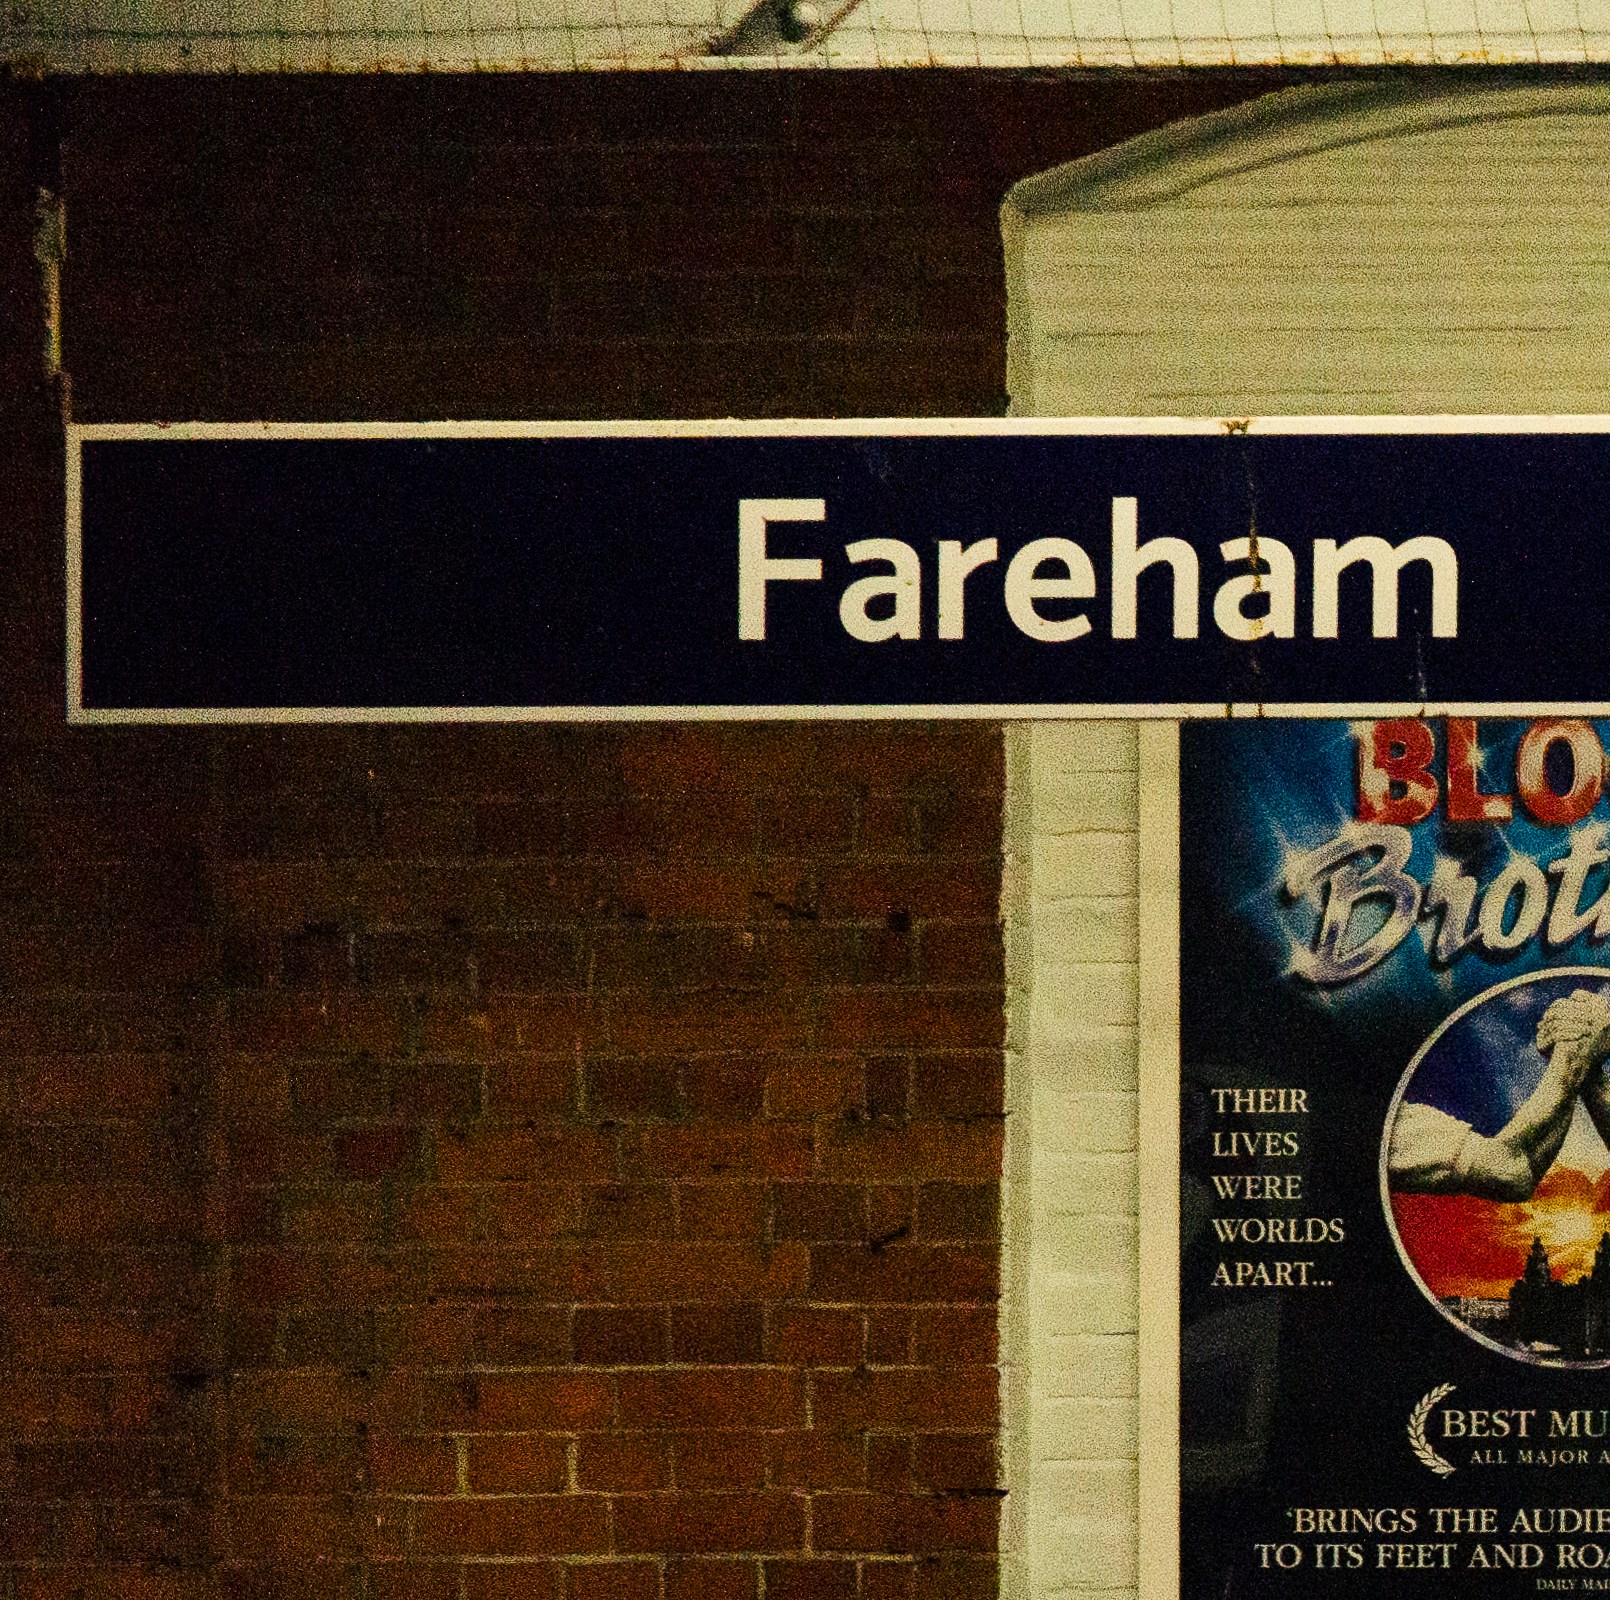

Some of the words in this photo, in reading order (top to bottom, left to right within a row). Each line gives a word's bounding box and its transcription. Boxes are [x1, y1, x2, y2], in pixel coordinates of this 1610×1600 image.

[739, 497, 1458, 642] Fareham
[1212, 1089, 1308, 1113] THEIR
[1214, 1132, 1299, 1156] LIVES
[1212, 1175, 1301, 1199] WERE
[1212, 1218, 1344, 1242] WORLDS
[1212, 1262, 1332, 1286] APART...
[1444, 1410, 1536, 1437] BEST
[1471, 1450, 1506, 1463] ALL
[1519, 1450, 1588, 1467] MAJOR
[1430, 1508, 1497, 1532] THE
[1255, 1544, 1302, 1568] TO
[1316, 1544, 1363, 1568] ITS
[1377, 1544, 1457, 1568] FEET
[1469, 1544, 1544, 1568] AND
[1536, 1578, 1574, 1591] DAILY
